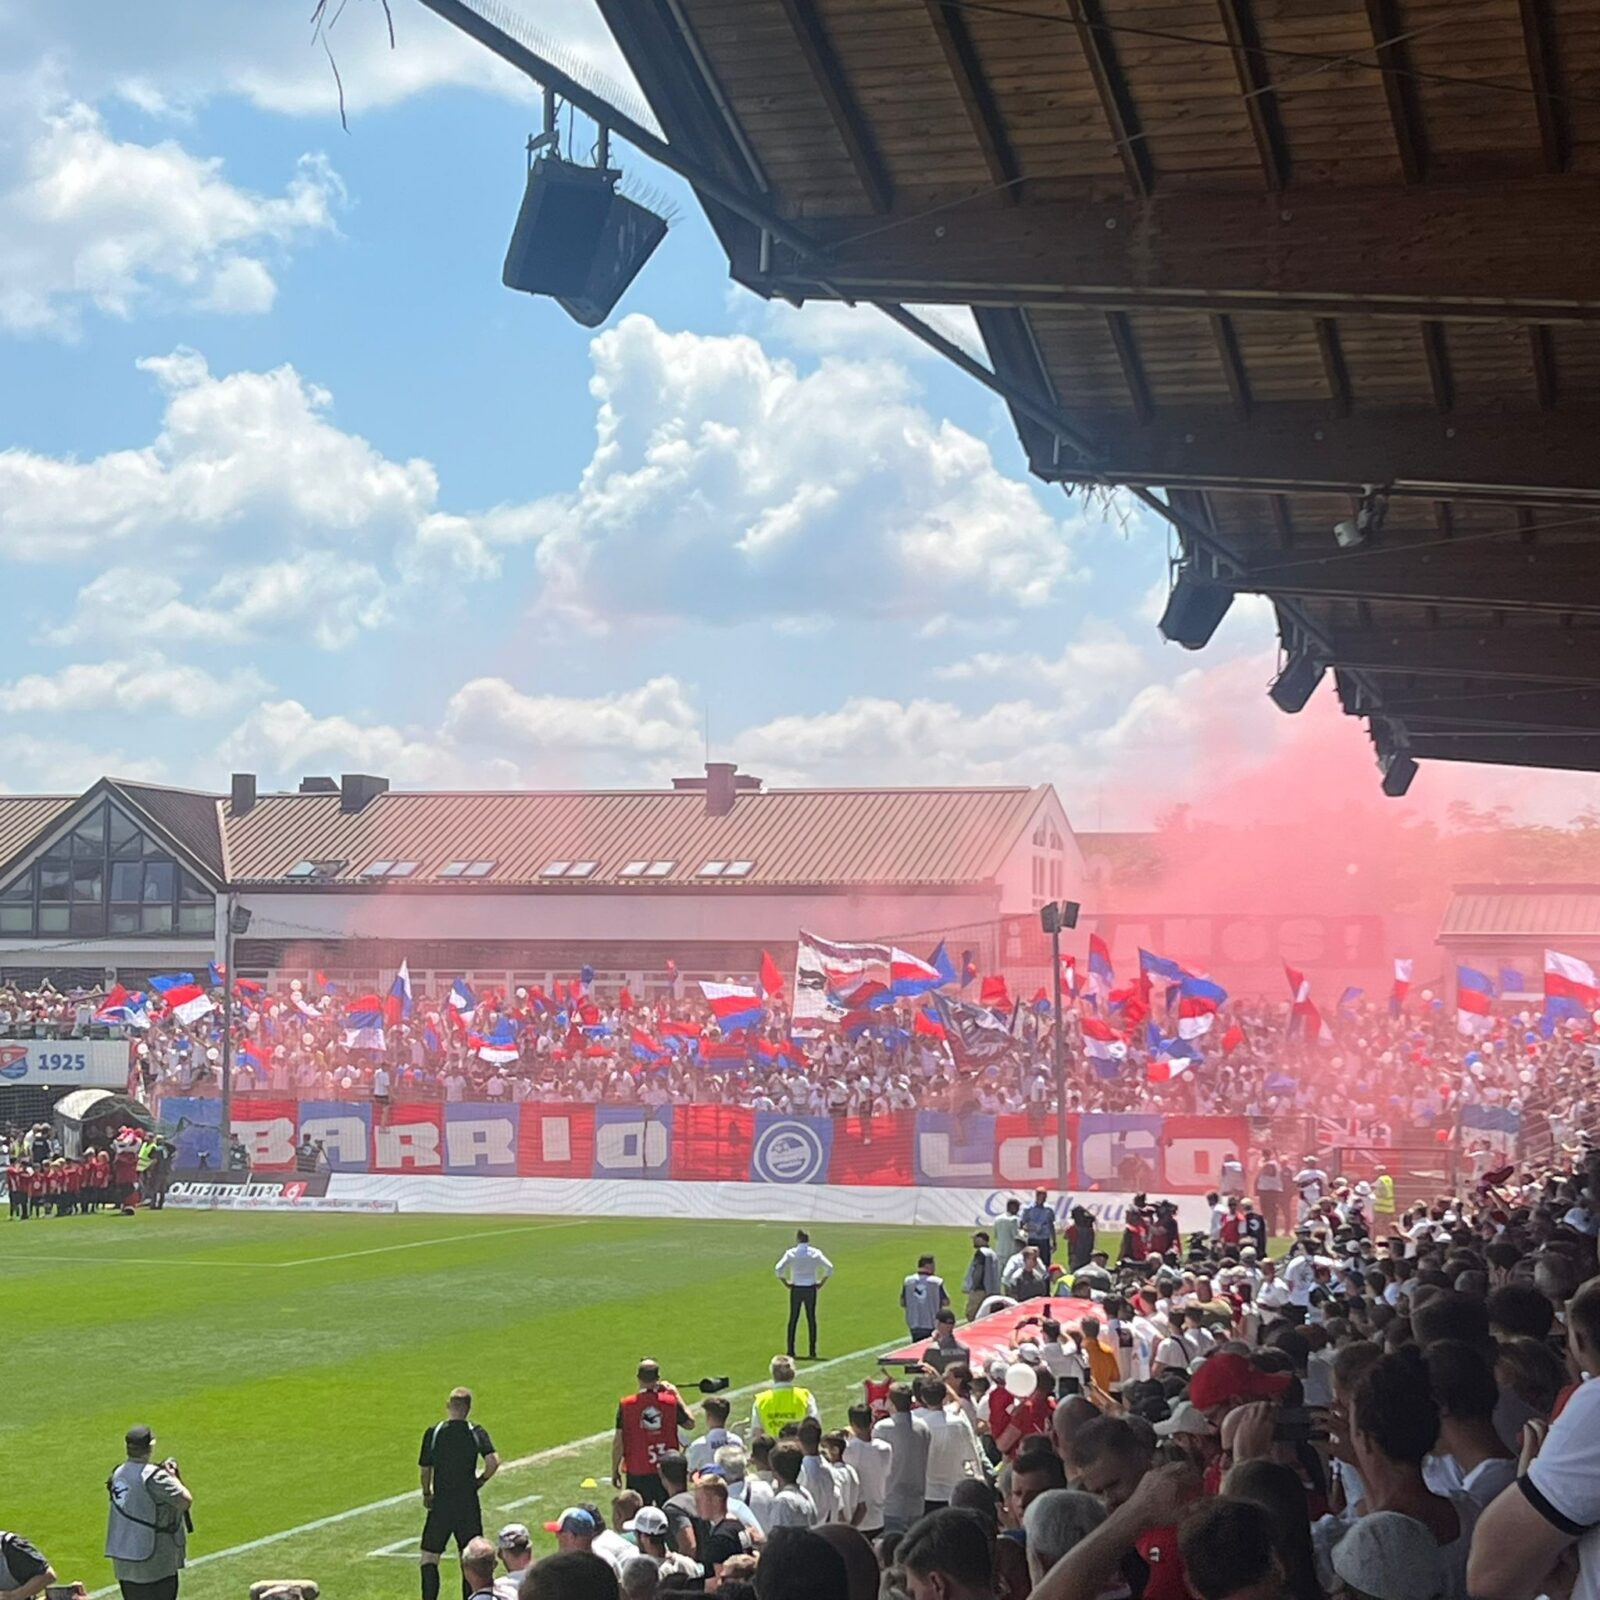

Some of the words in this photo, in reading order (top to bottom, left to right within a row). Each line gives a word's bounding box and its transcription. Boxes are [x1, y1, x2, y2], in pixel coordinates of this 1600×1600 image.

[38, 1053, 85, 1071] 1925
[230, 1116, 668, 1169] BARRIO
[920, 1130, 1240, 1187] LOCO
